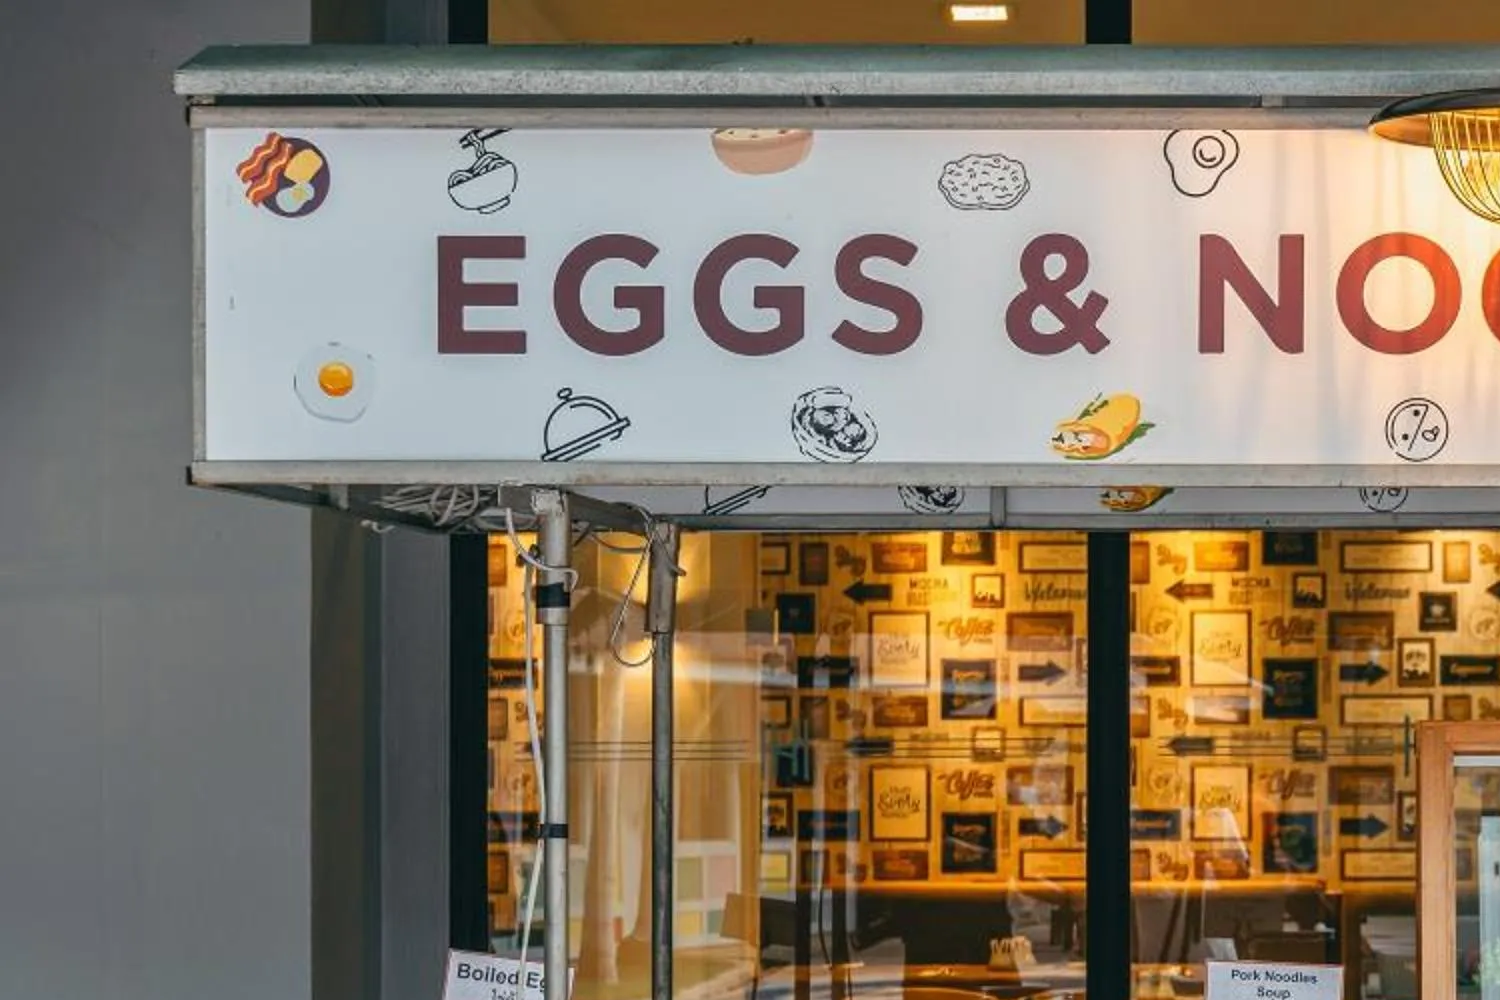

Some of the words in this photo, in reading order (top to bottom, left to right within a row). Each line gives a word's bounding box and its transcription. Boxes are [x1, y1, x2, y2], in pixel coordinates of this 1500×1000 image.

[437, 233, 923, 356] EGGS
[1005, 233, 1111, 355] &
[456, 962, 519, 985] Boiled
[1231, 968, 1261, 981] Pork
[1265, 969, 1318, 985] Noodles
[1257, 985, 1291, 1000] Soup
